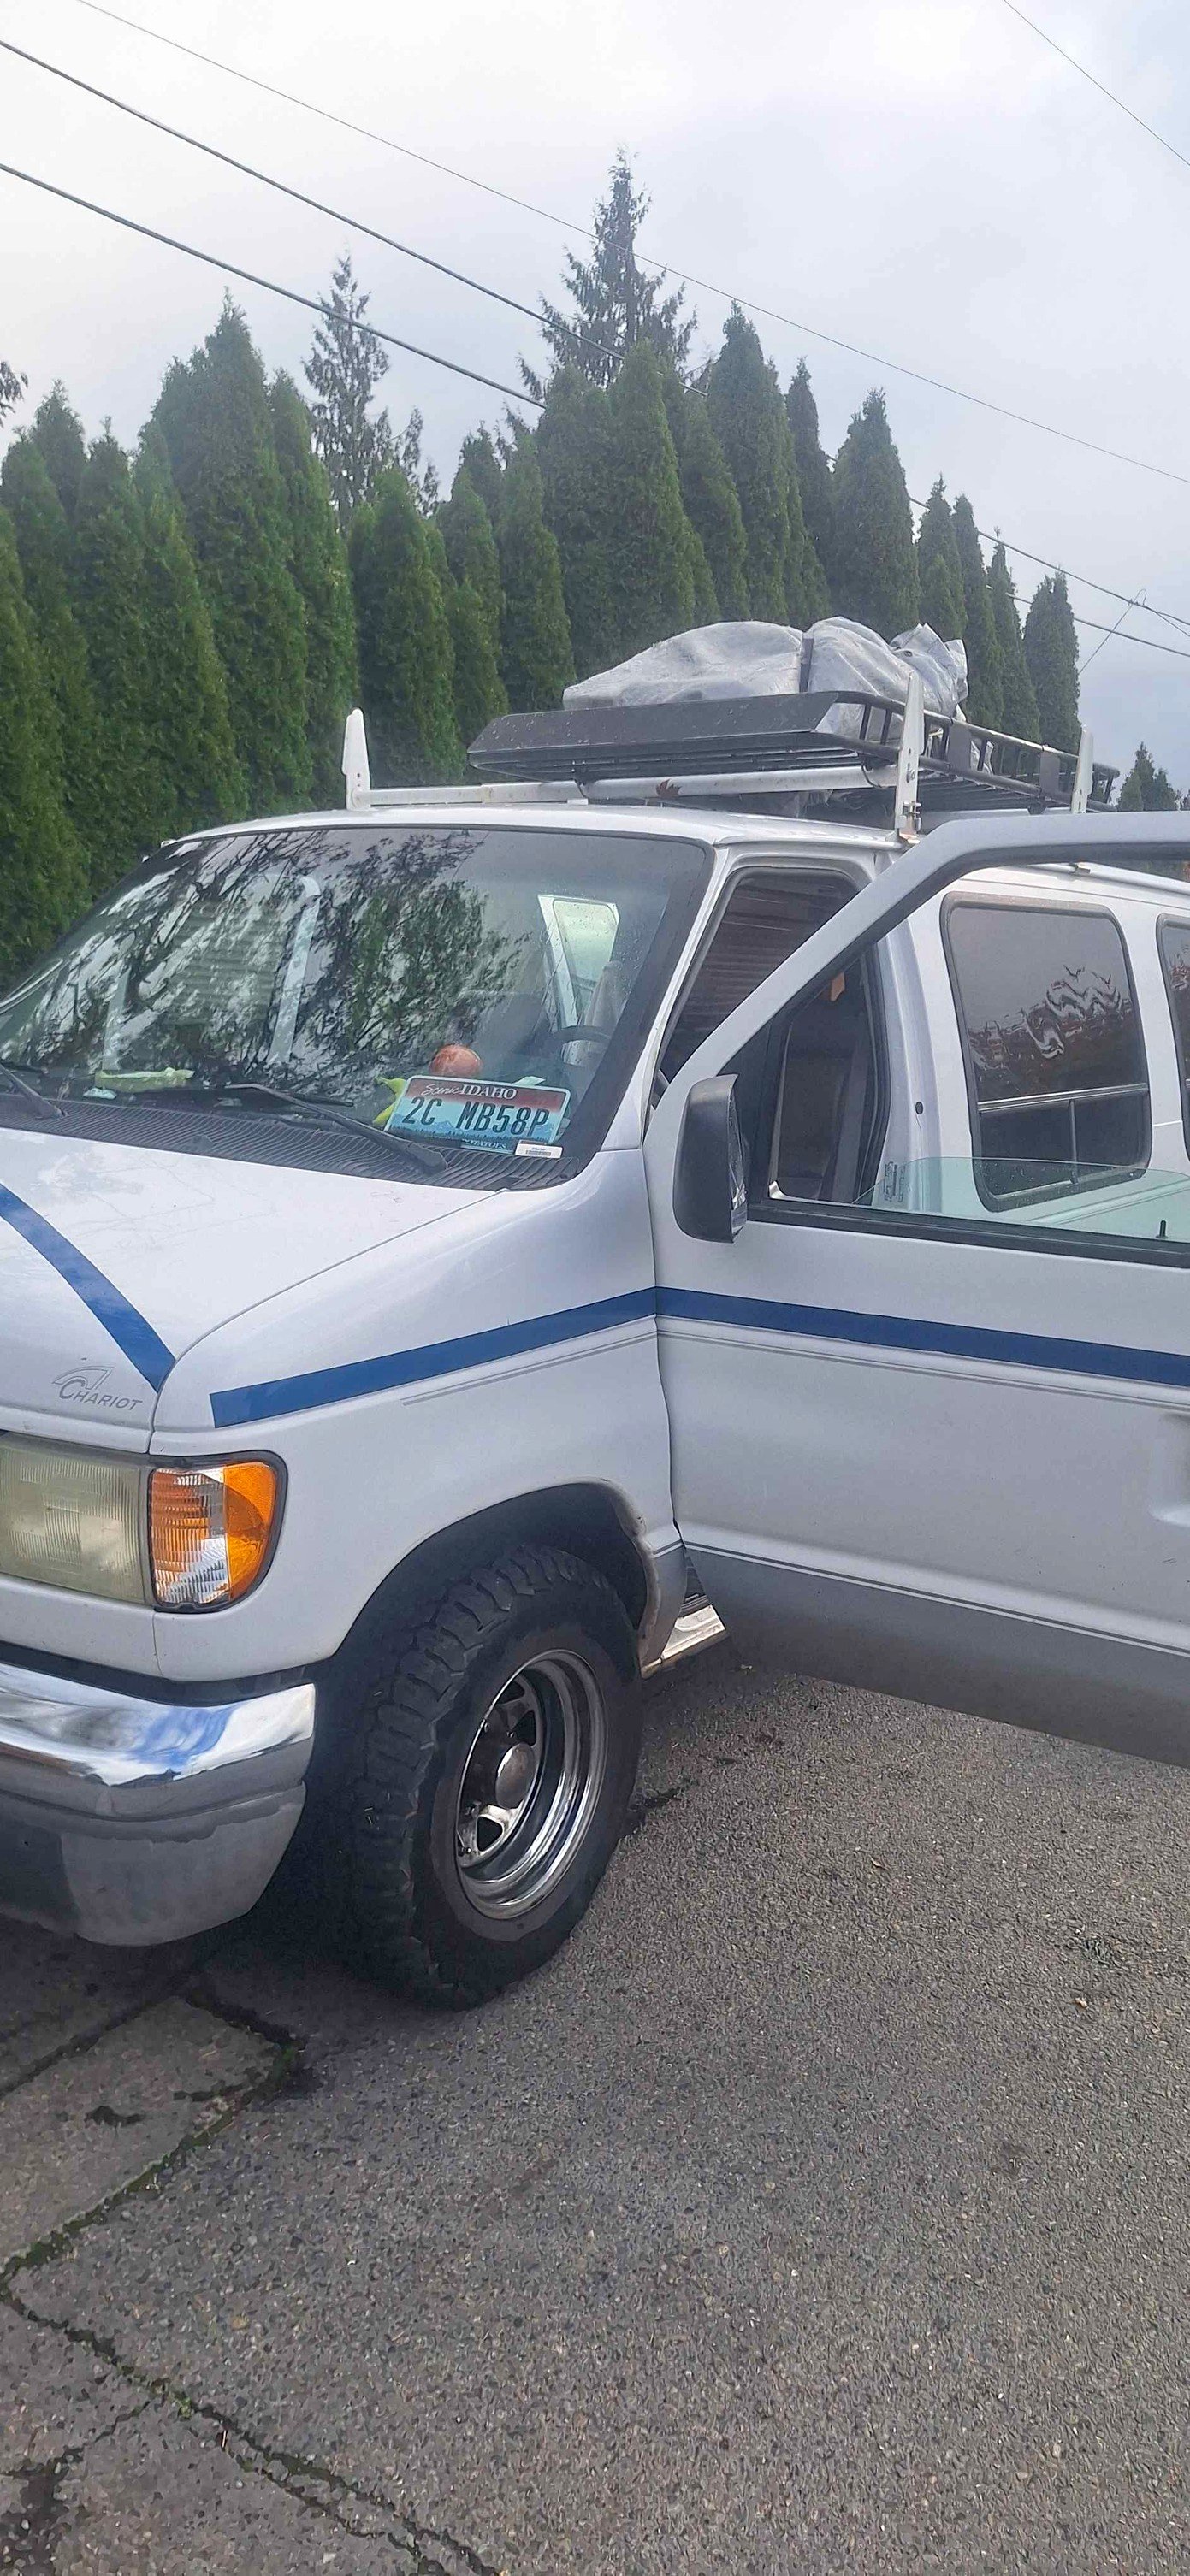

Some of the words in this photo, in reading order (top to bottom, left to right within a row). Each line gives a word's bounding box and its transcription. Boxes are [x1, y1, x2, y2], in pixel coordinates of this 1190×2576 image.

[420, 1084, 460, 1096] Scenic
[460, 1084, 517, 1100] IDAHO
[402, 1096, 442, 1126] 2C
[455, 1101, 550, 1136] MB58P
